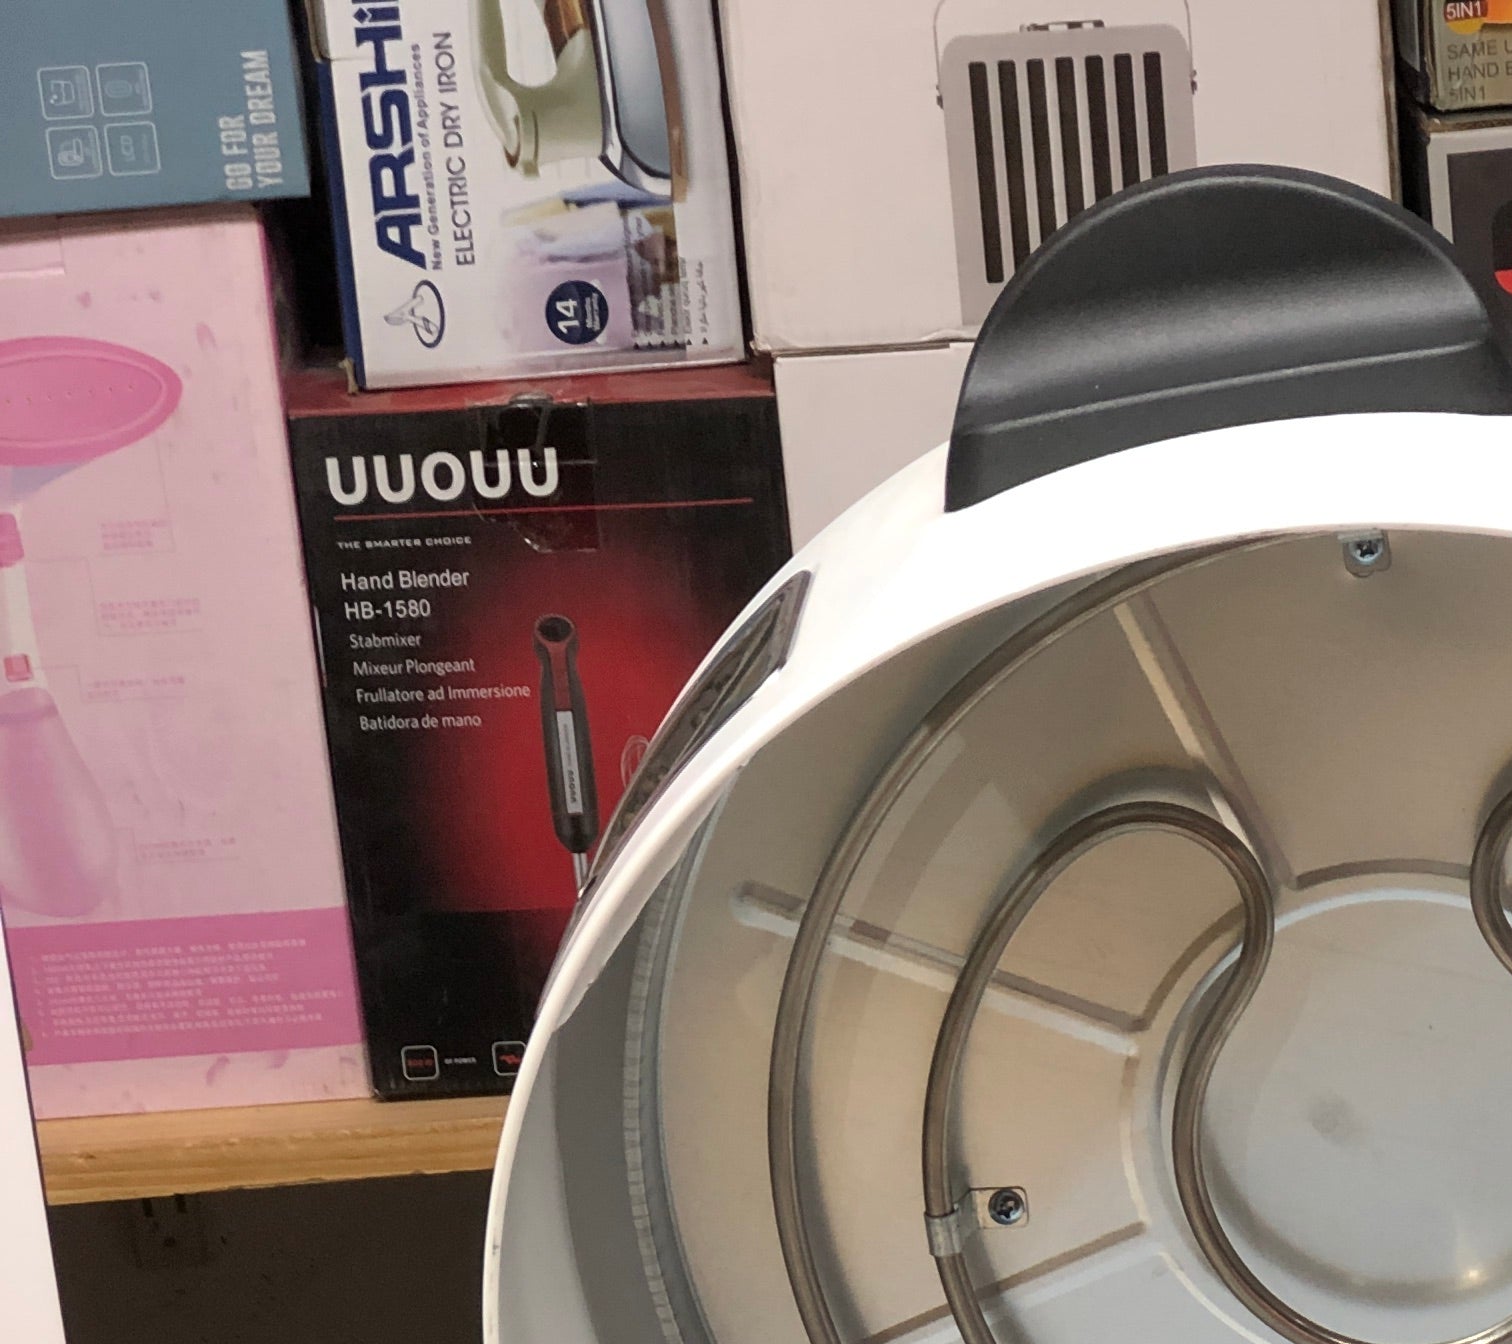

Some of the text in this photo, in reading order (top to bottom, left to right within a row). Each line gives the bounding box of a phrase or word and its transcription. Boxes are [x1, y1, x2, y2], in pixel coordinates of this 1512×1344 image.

[1447, 39, 1498, 60] SAME
[1448, 61, 1500, 82] HAND
[240, 50, 285, 189] YOUR DREAM
[218, 114, 252, 191] GO FOR
[411, 44, 443, 271] New Generation of Appliances
[432, 32, 476, 266] ELECTRIC DRY IRON
[555, 298, 581, 335] 14
[325, 446, 559, 506] UUOUU
[337, 535, 472, 550] THE SMARTER CHOICE
[341, 568, 471, 592] Hand Blender
[344, 598, 432, 621] HB-1580
[350, 633, 422, 650] Stabmixer
[353, 657, 476, 677] Mixeur Plongeant
[356, 683, 531, 704] Frullatore ad Immersione
[360, 712, 483, 731] Batidora de mano
